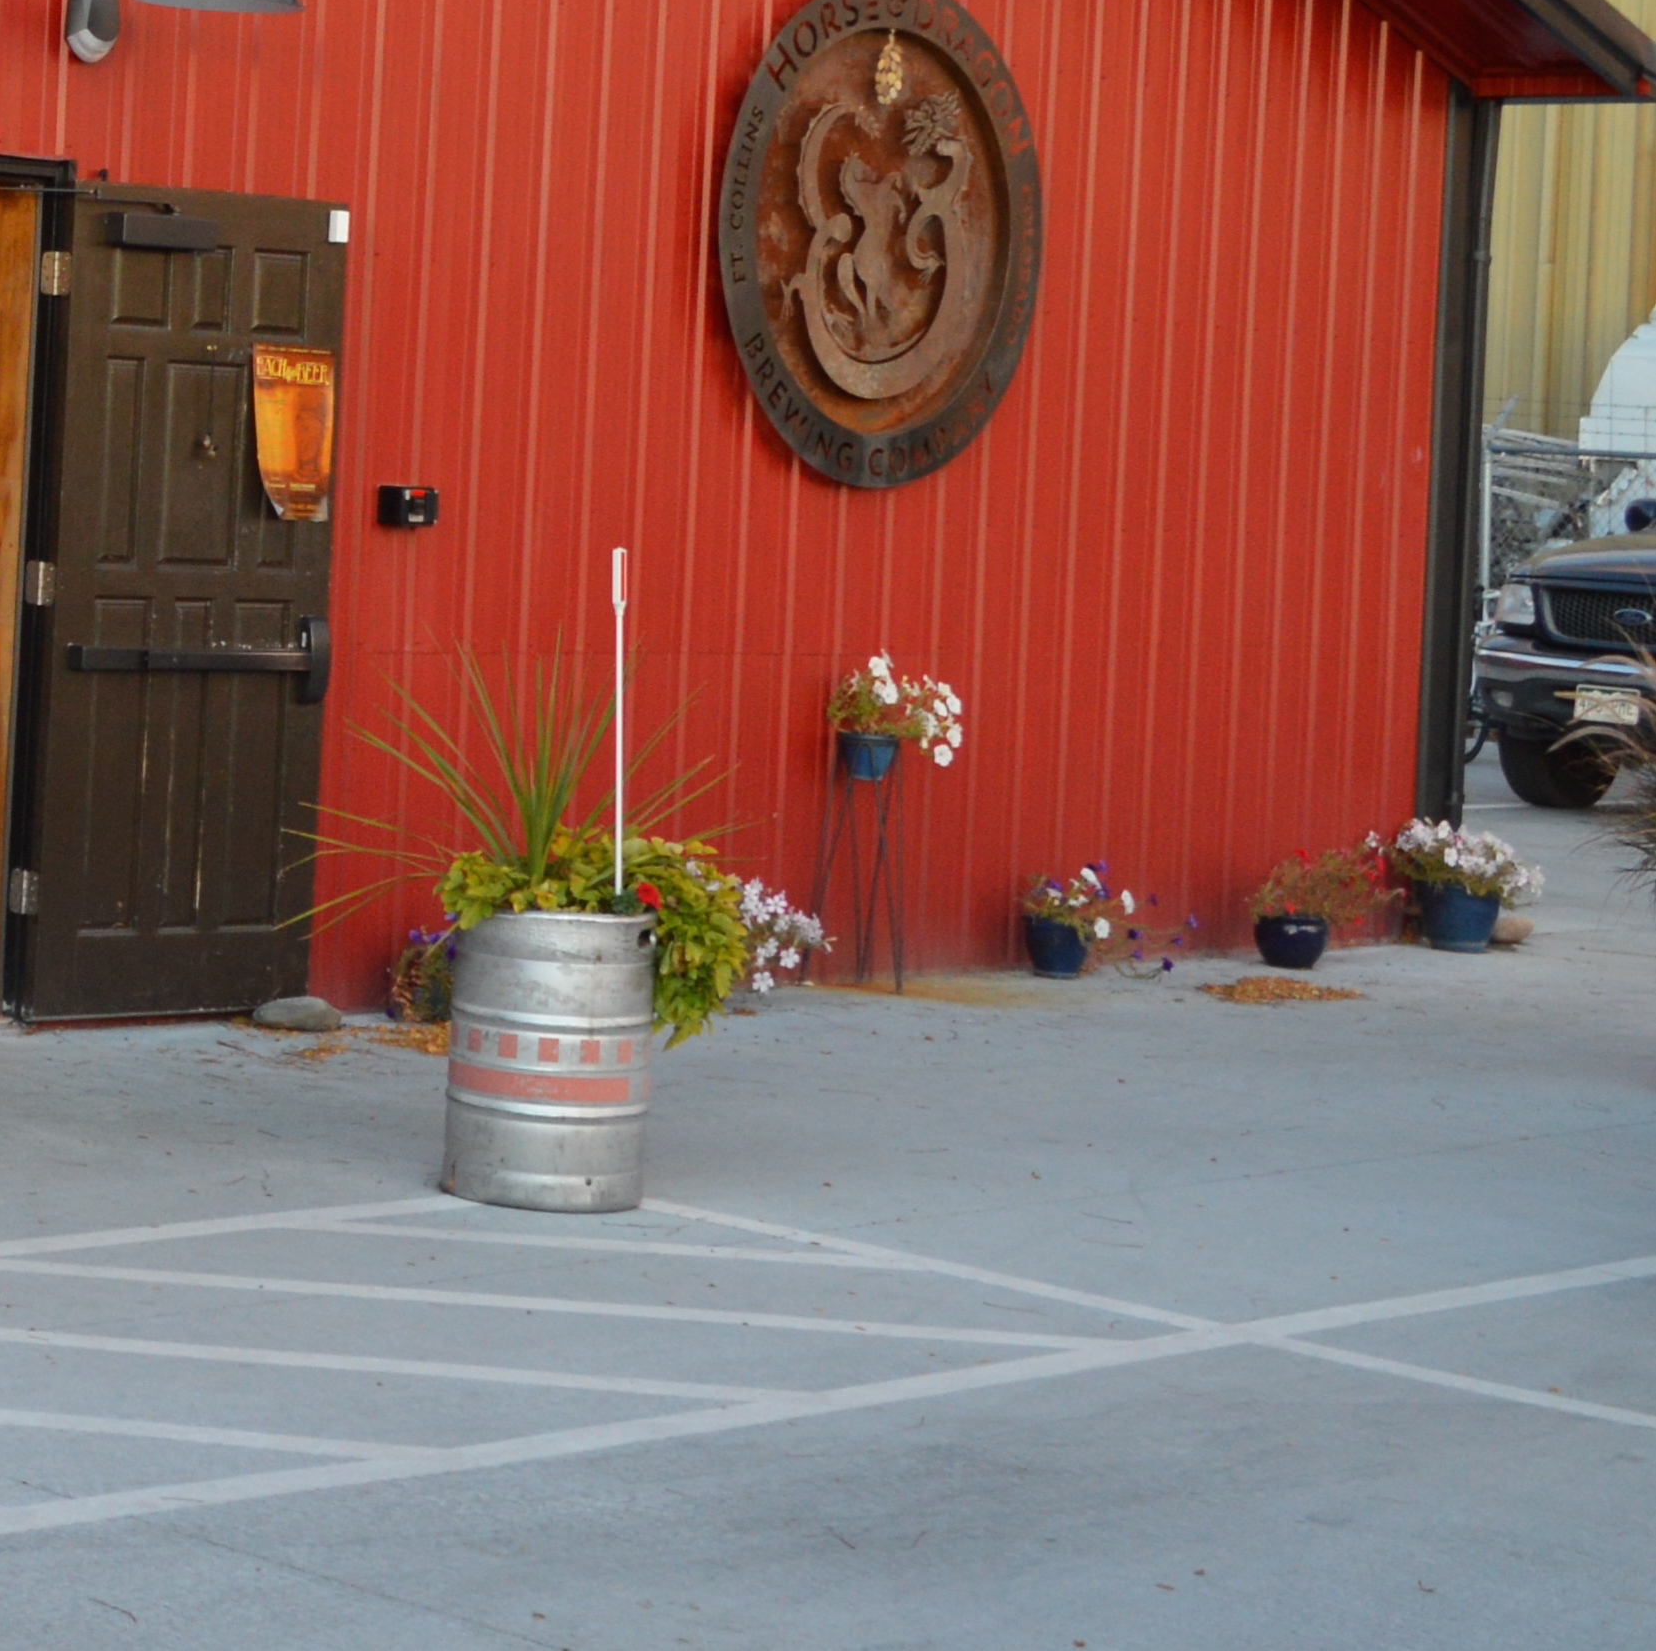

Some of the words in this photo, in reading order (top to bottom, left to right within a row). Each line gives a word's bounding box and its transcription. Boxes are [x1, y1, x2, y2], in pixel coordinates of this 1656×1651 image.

[730, 105, 764, 231] COLLINS
[745, 332, 854, 471] BREWING
[868, 372, 996, 476] COMPANY
